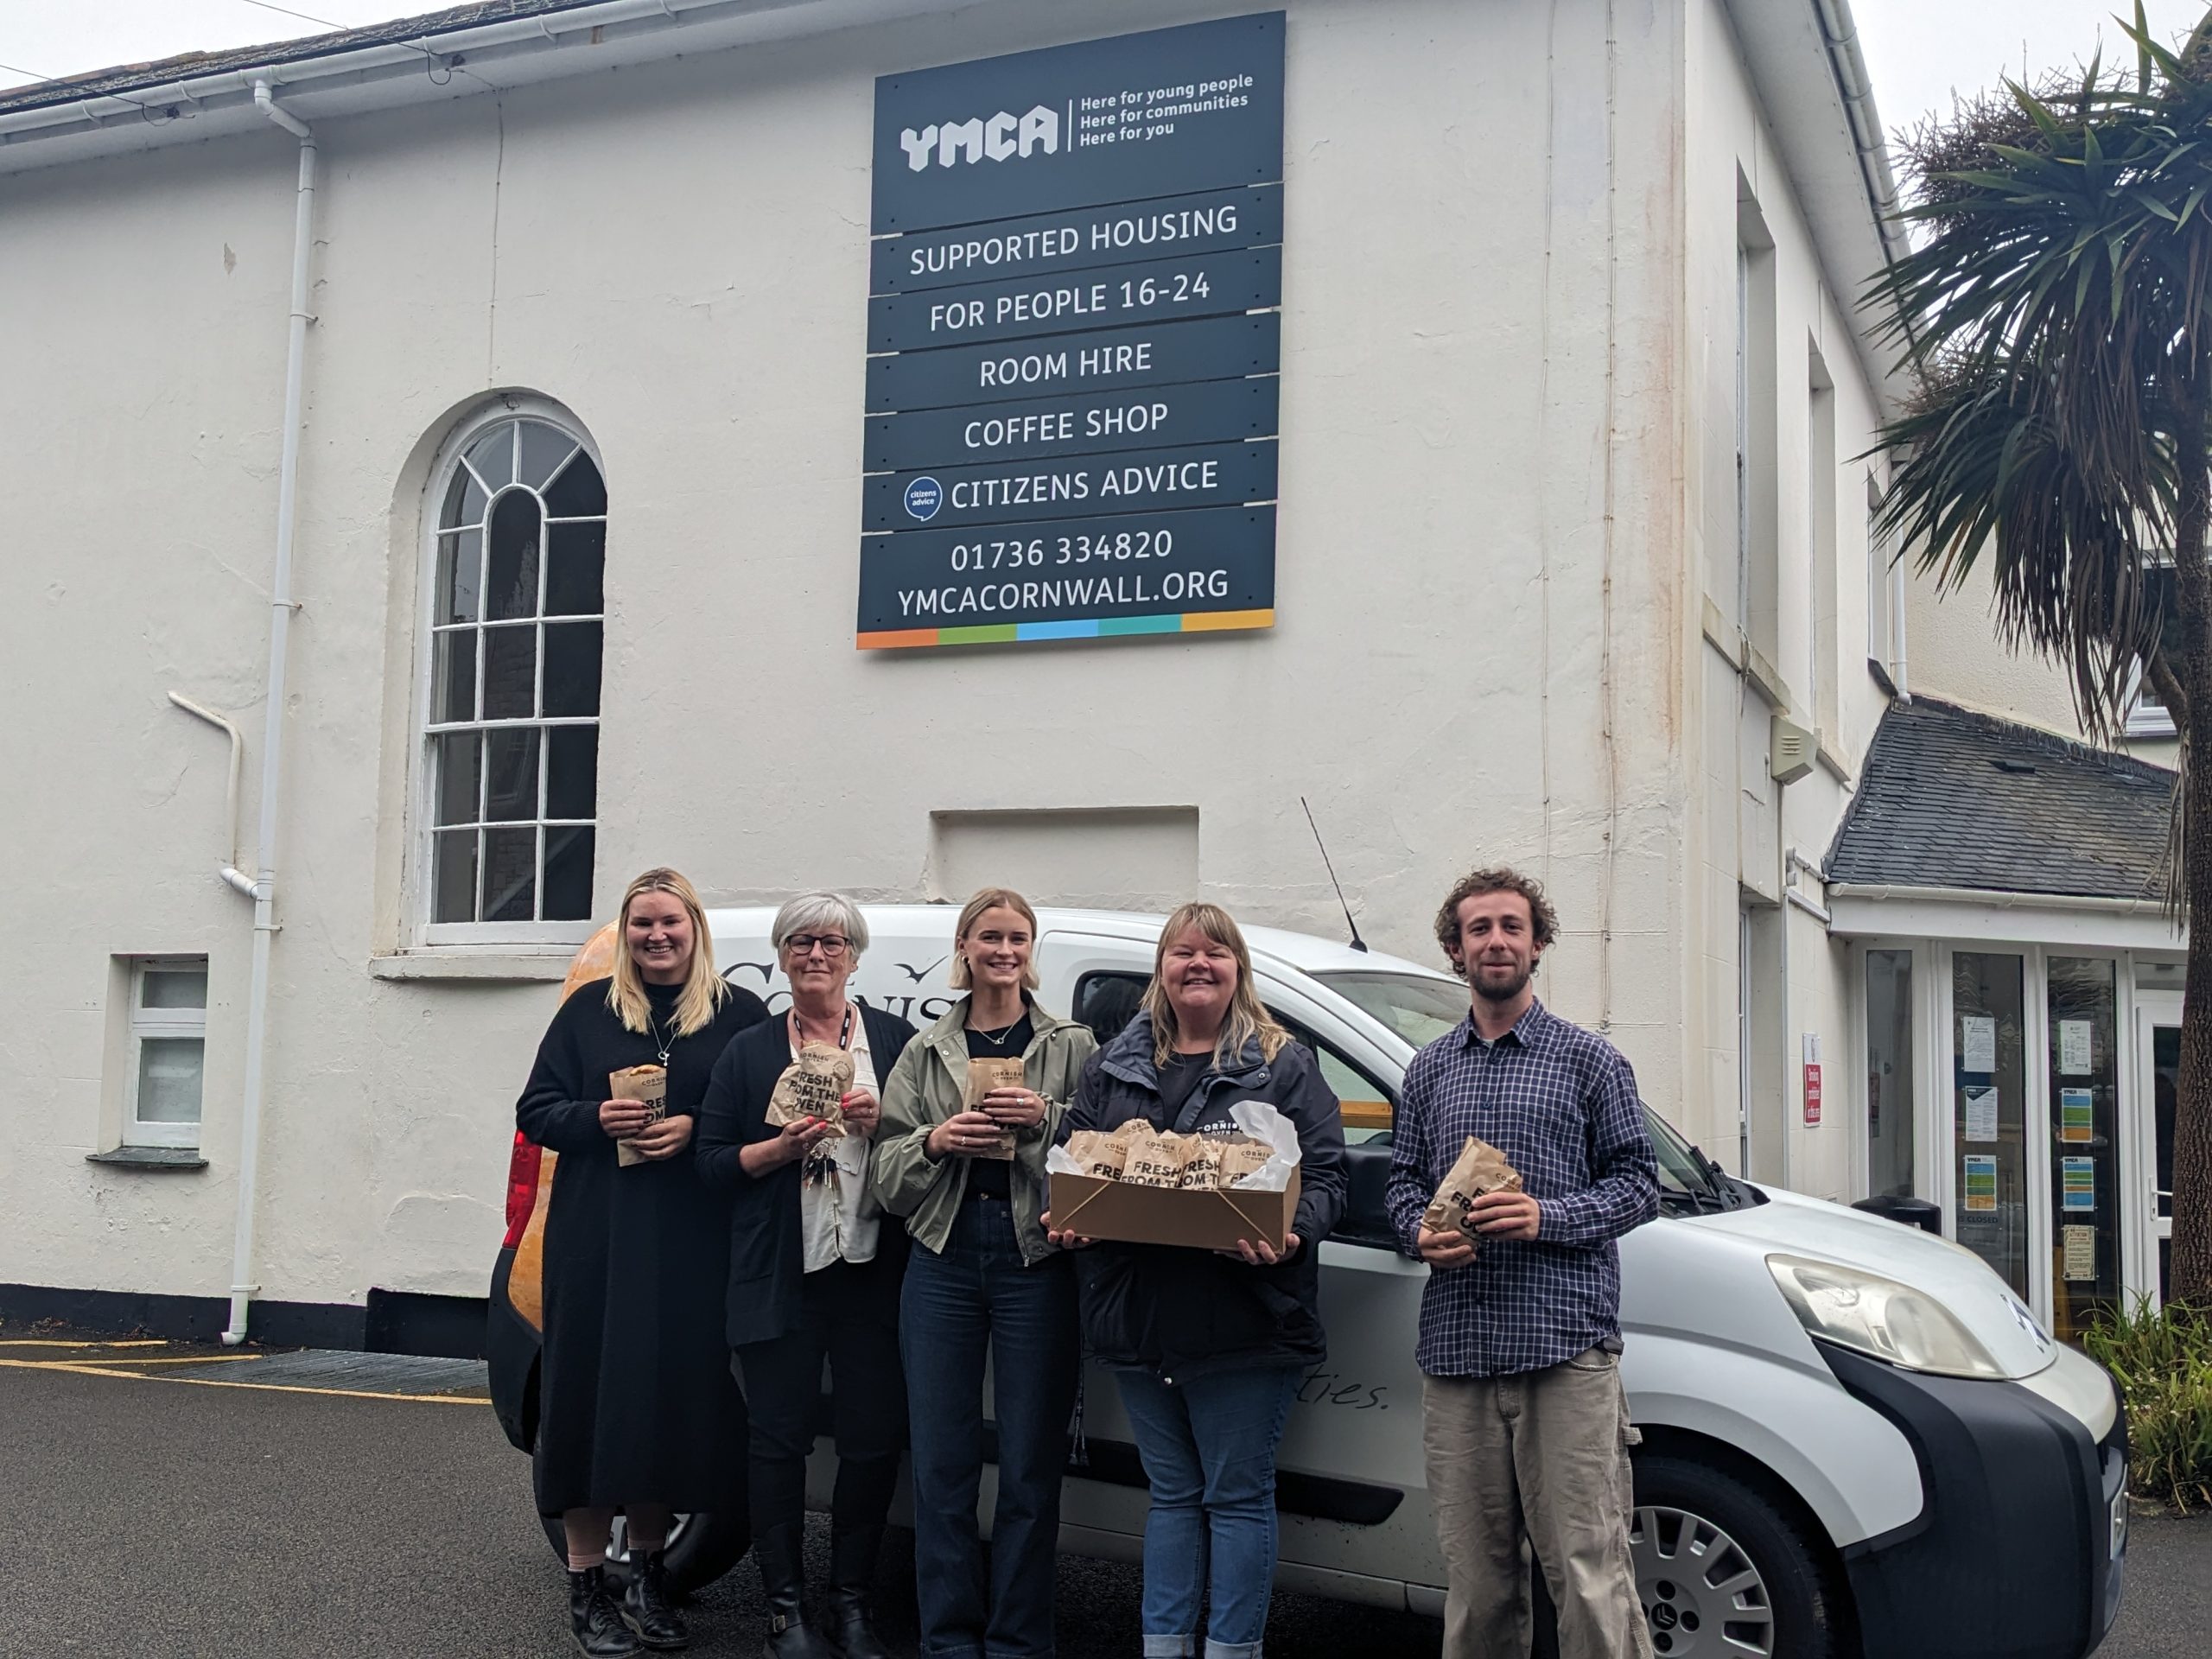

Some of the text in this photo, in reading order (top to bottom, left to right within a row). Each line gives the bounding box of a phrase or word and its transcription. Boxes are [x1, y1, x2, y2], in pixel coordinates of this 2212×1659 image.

[1081, 73, 1253, 111] Here for young people
[1080, 94, 1249, 130] Here for communities
[900, 105, 1058, 172] YMCA
[1080, 123, 1174, 147] Here for you
[910, 206, 1237, 276] SUPPORTED HOUSING
[930, 272, 1210, 332] FOR PEOPLE 16-24
[980, 343, 1152, 387] ROOM HIRE
[964, 403, 1168, 448] COFFEE SHOP
[910, 490, 937, 499] citizens
[912, 498, 935, 506] advice
[951, 461, 1218, 509] CITIZENS ADVICE
[950, 530, 1173, 571] 01736 334820
[898, 569, 1229, 617] YMCACORNWALL.ORG
[798, 1071, 833, 1088] RESH
[817, 1088, 841, 1103] THE
[1093, 1163, 1123, 1180] FRE
[1241, 1150, 1270, 1159] CORNIS
